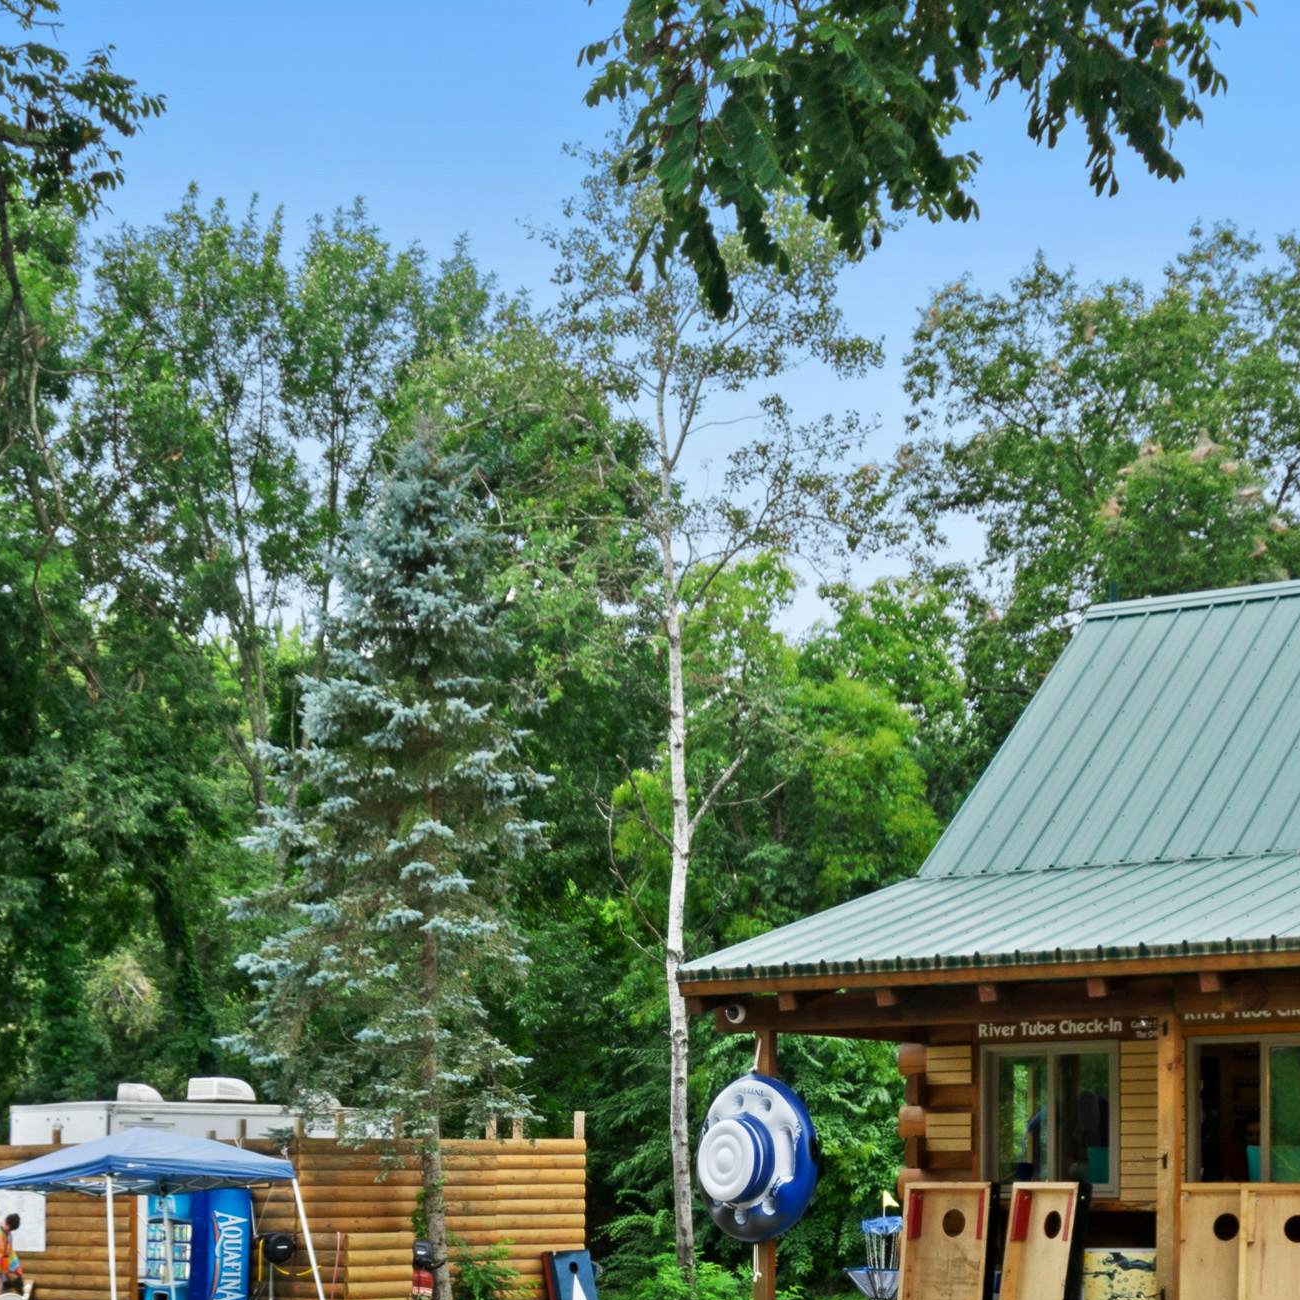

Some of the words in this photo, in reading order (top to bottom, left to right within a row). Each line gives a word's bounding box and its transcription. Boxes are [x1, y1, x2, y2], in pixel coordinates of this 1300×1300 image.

[978, 1023, 1016, 1037] River
[1021, 1021, 1055, 1036] Tube
[1059, 1017, 1123, 1035] Check-In
